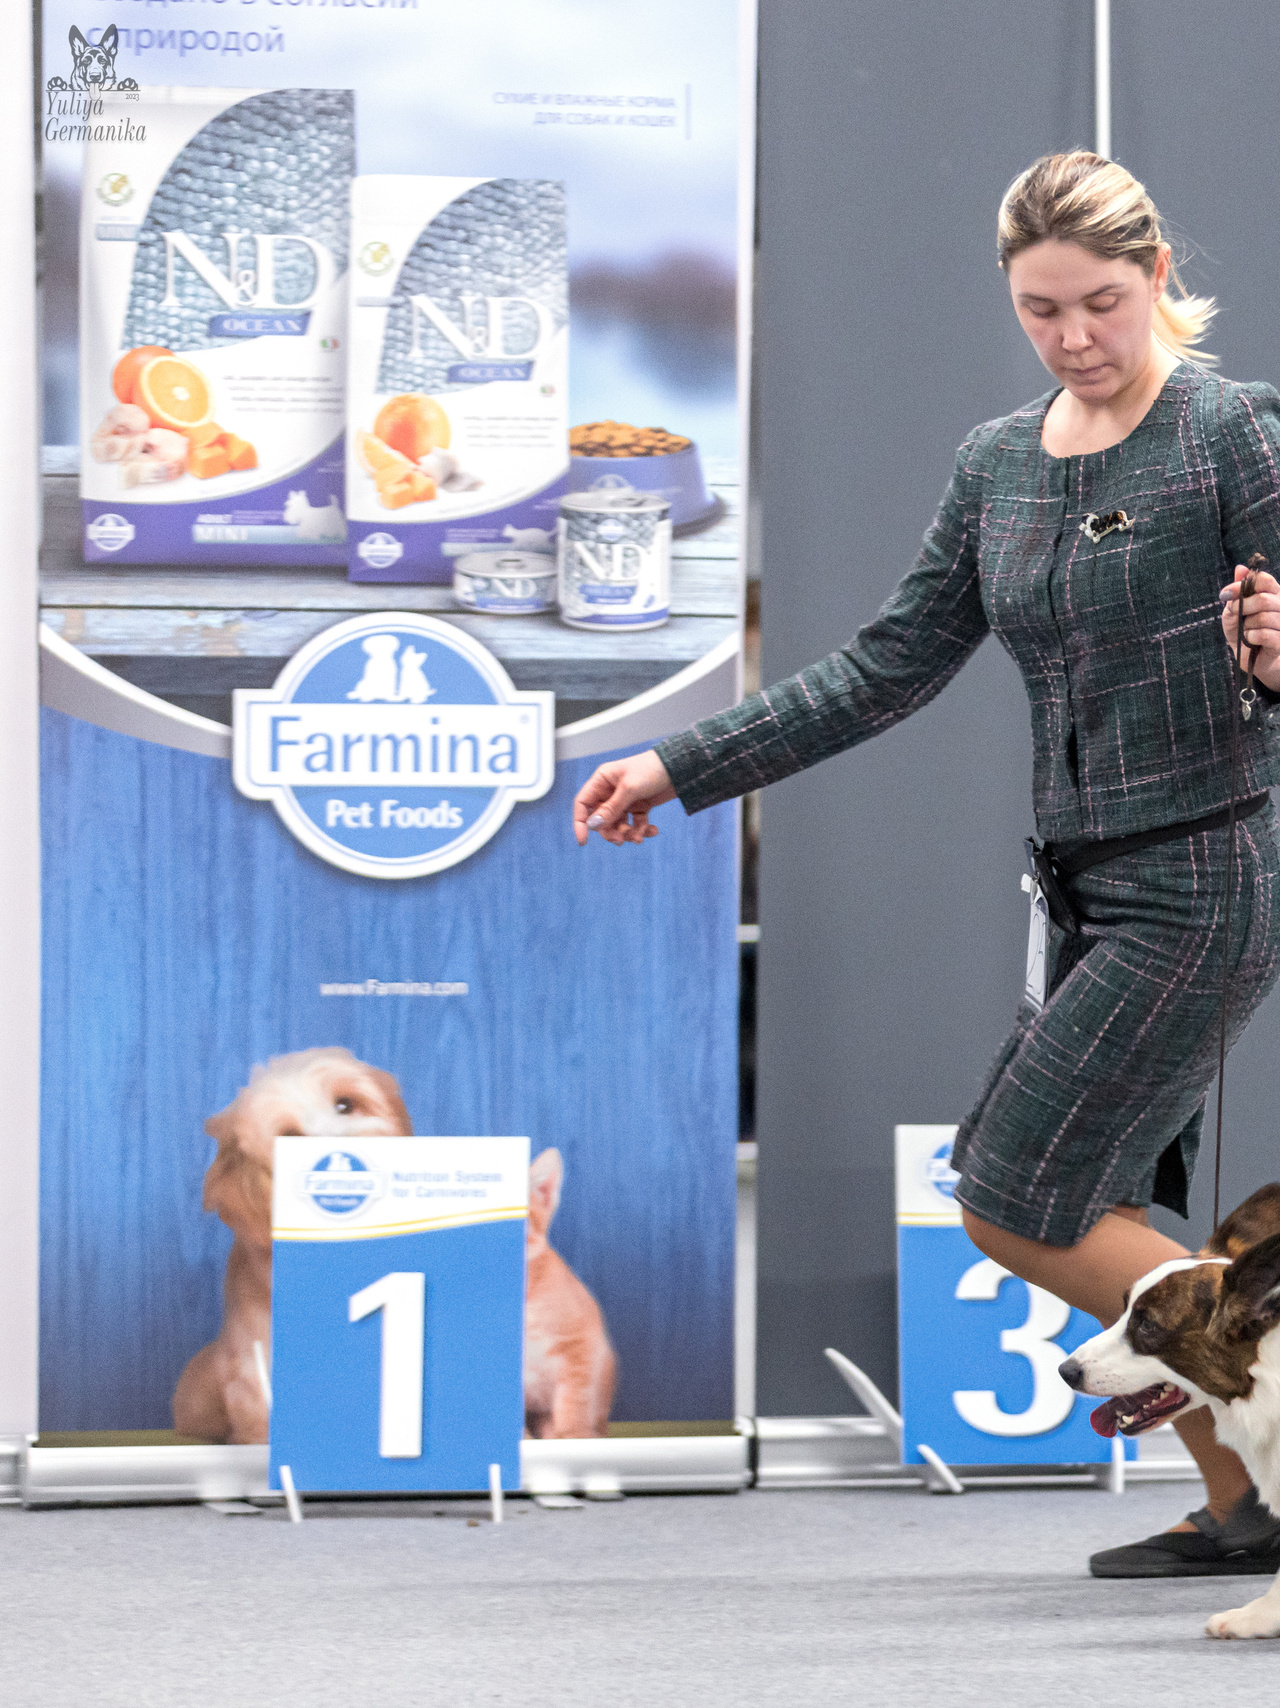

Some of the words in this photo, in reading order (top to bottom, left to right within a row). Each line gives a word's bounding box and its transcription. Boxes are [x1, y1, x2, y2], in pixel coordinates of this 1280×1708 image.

[117, 26, 285, 57] природой
[222, 317, 302, 333] OCEAN
[457, 364, 527, 379] OCEAN
[269, 715, 519, 774] Farmina
[326, 799, 374, 828] Pet
[379, 799, 464, 829] Foods
[304, 1173, 377, 1191] Farmina
[455, 1170, 503, 1187] System
[952, 1257, 1076, 1438] 3
[348, 1271, 426, 1459] 1
